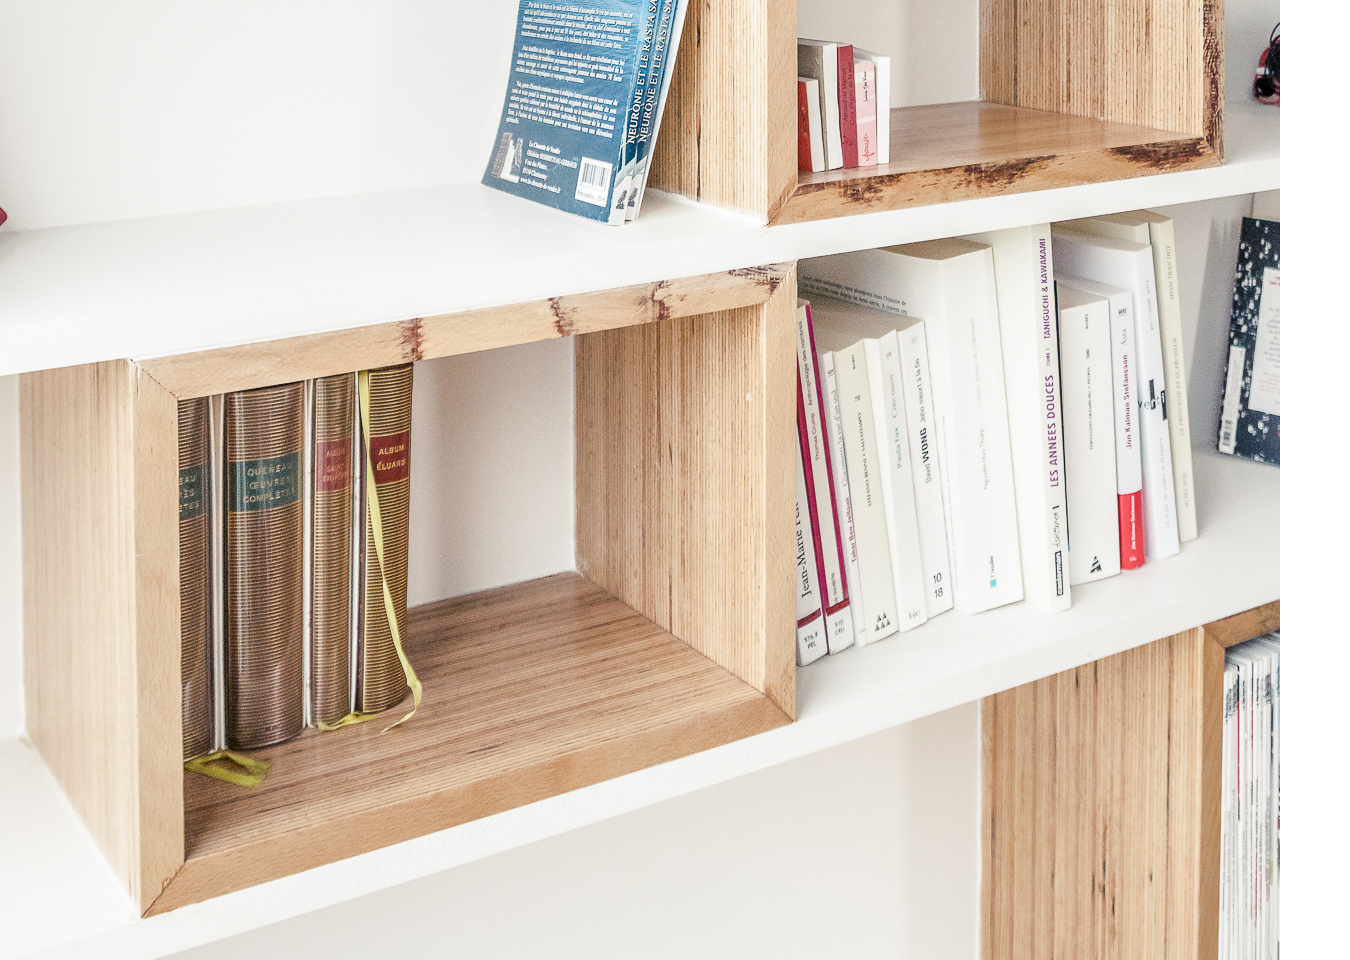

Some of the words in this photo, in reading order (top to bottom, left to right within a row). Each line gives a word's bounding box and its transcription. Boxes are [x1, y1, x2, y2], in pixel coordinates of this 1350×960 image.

[641, 13, 655, 52] RASTA
[655, 14, 669, 51] RASTA
[639, 53, 648, 68] LE
[652, 53, 662, 68] LE
[636, 70, 646, 85] ET
[649, 70, 659, 85] ET
[626, 87, 644, 144] NEURONE
[638, 86, 657, 141] NEURONE
[1038, 237, 1048, 283] KAWAKAMI
[1041, 294, 1050, 339] TANIGUCHI
[912, 357, 920, 367] fin
[913, 368, 920, 376] la
[802, 362, 814, 405] Anthropologie
[1044, 373, 1055, 417] DOUCES
[809, 412, 818, 434] Crump
[917, 405, 926, 422] John
[1123, 401, 1131, 432] Kalman
[378, 444, 405, 456] ALBUM
[812, 434, 821, 461] Thomas
[919, 426, 930, 463] WONG
[1047, 421, 1058, 465] ANNEES
[376, 458, 407, 471] ÉLUARD
[923, 462, 932, 483] David
[1050, 468, 1059, 486] LES
[792, 528, 812, 598] Jean-Marie
[933, 572, 942, 584] 10
[934, 586, 944, 598] 18
[834, 627, 845, 636] CRU
[807, 640, 817, 650] PEL
